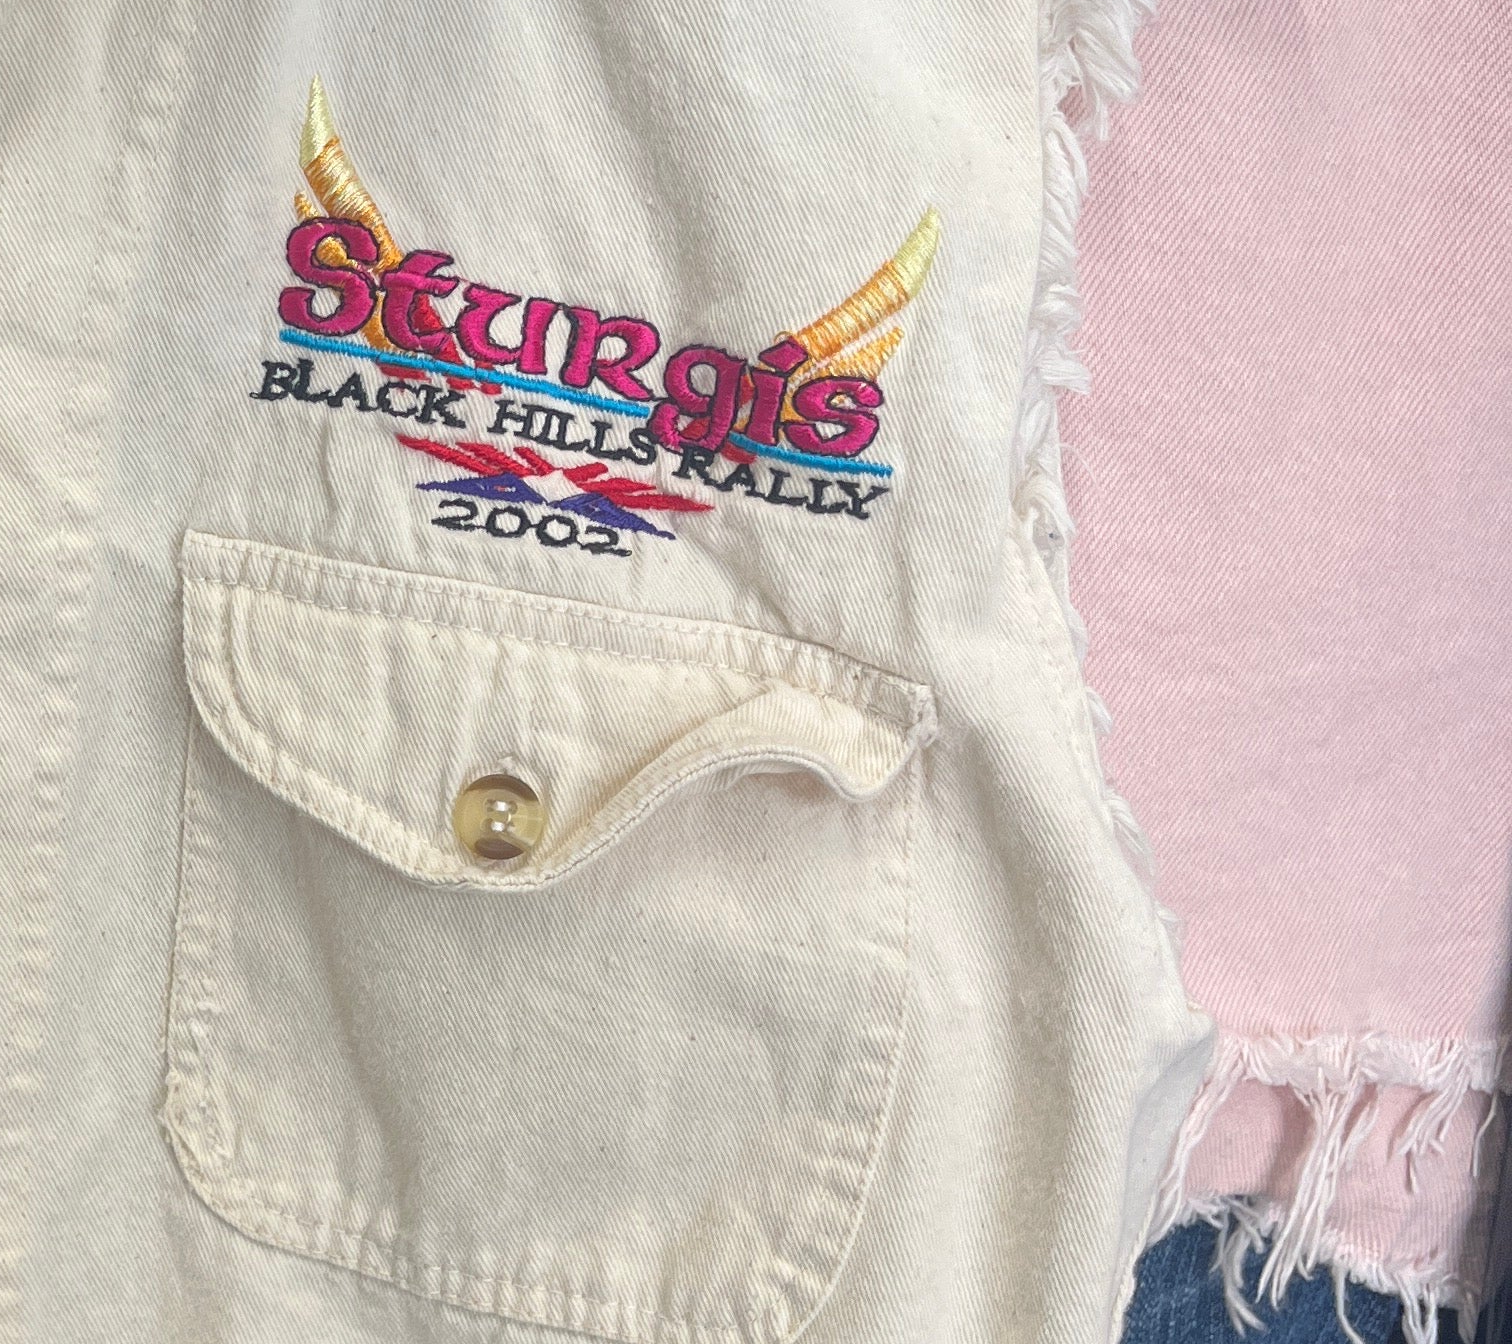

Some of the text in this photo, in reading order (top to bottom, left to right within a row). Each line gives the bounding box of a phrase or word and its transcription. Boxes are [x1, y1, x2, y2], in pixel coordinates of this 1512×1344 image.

[249, 358, 890, 521] BLACK HILLS RALLY
[431, 498, 633, 557] 2002
